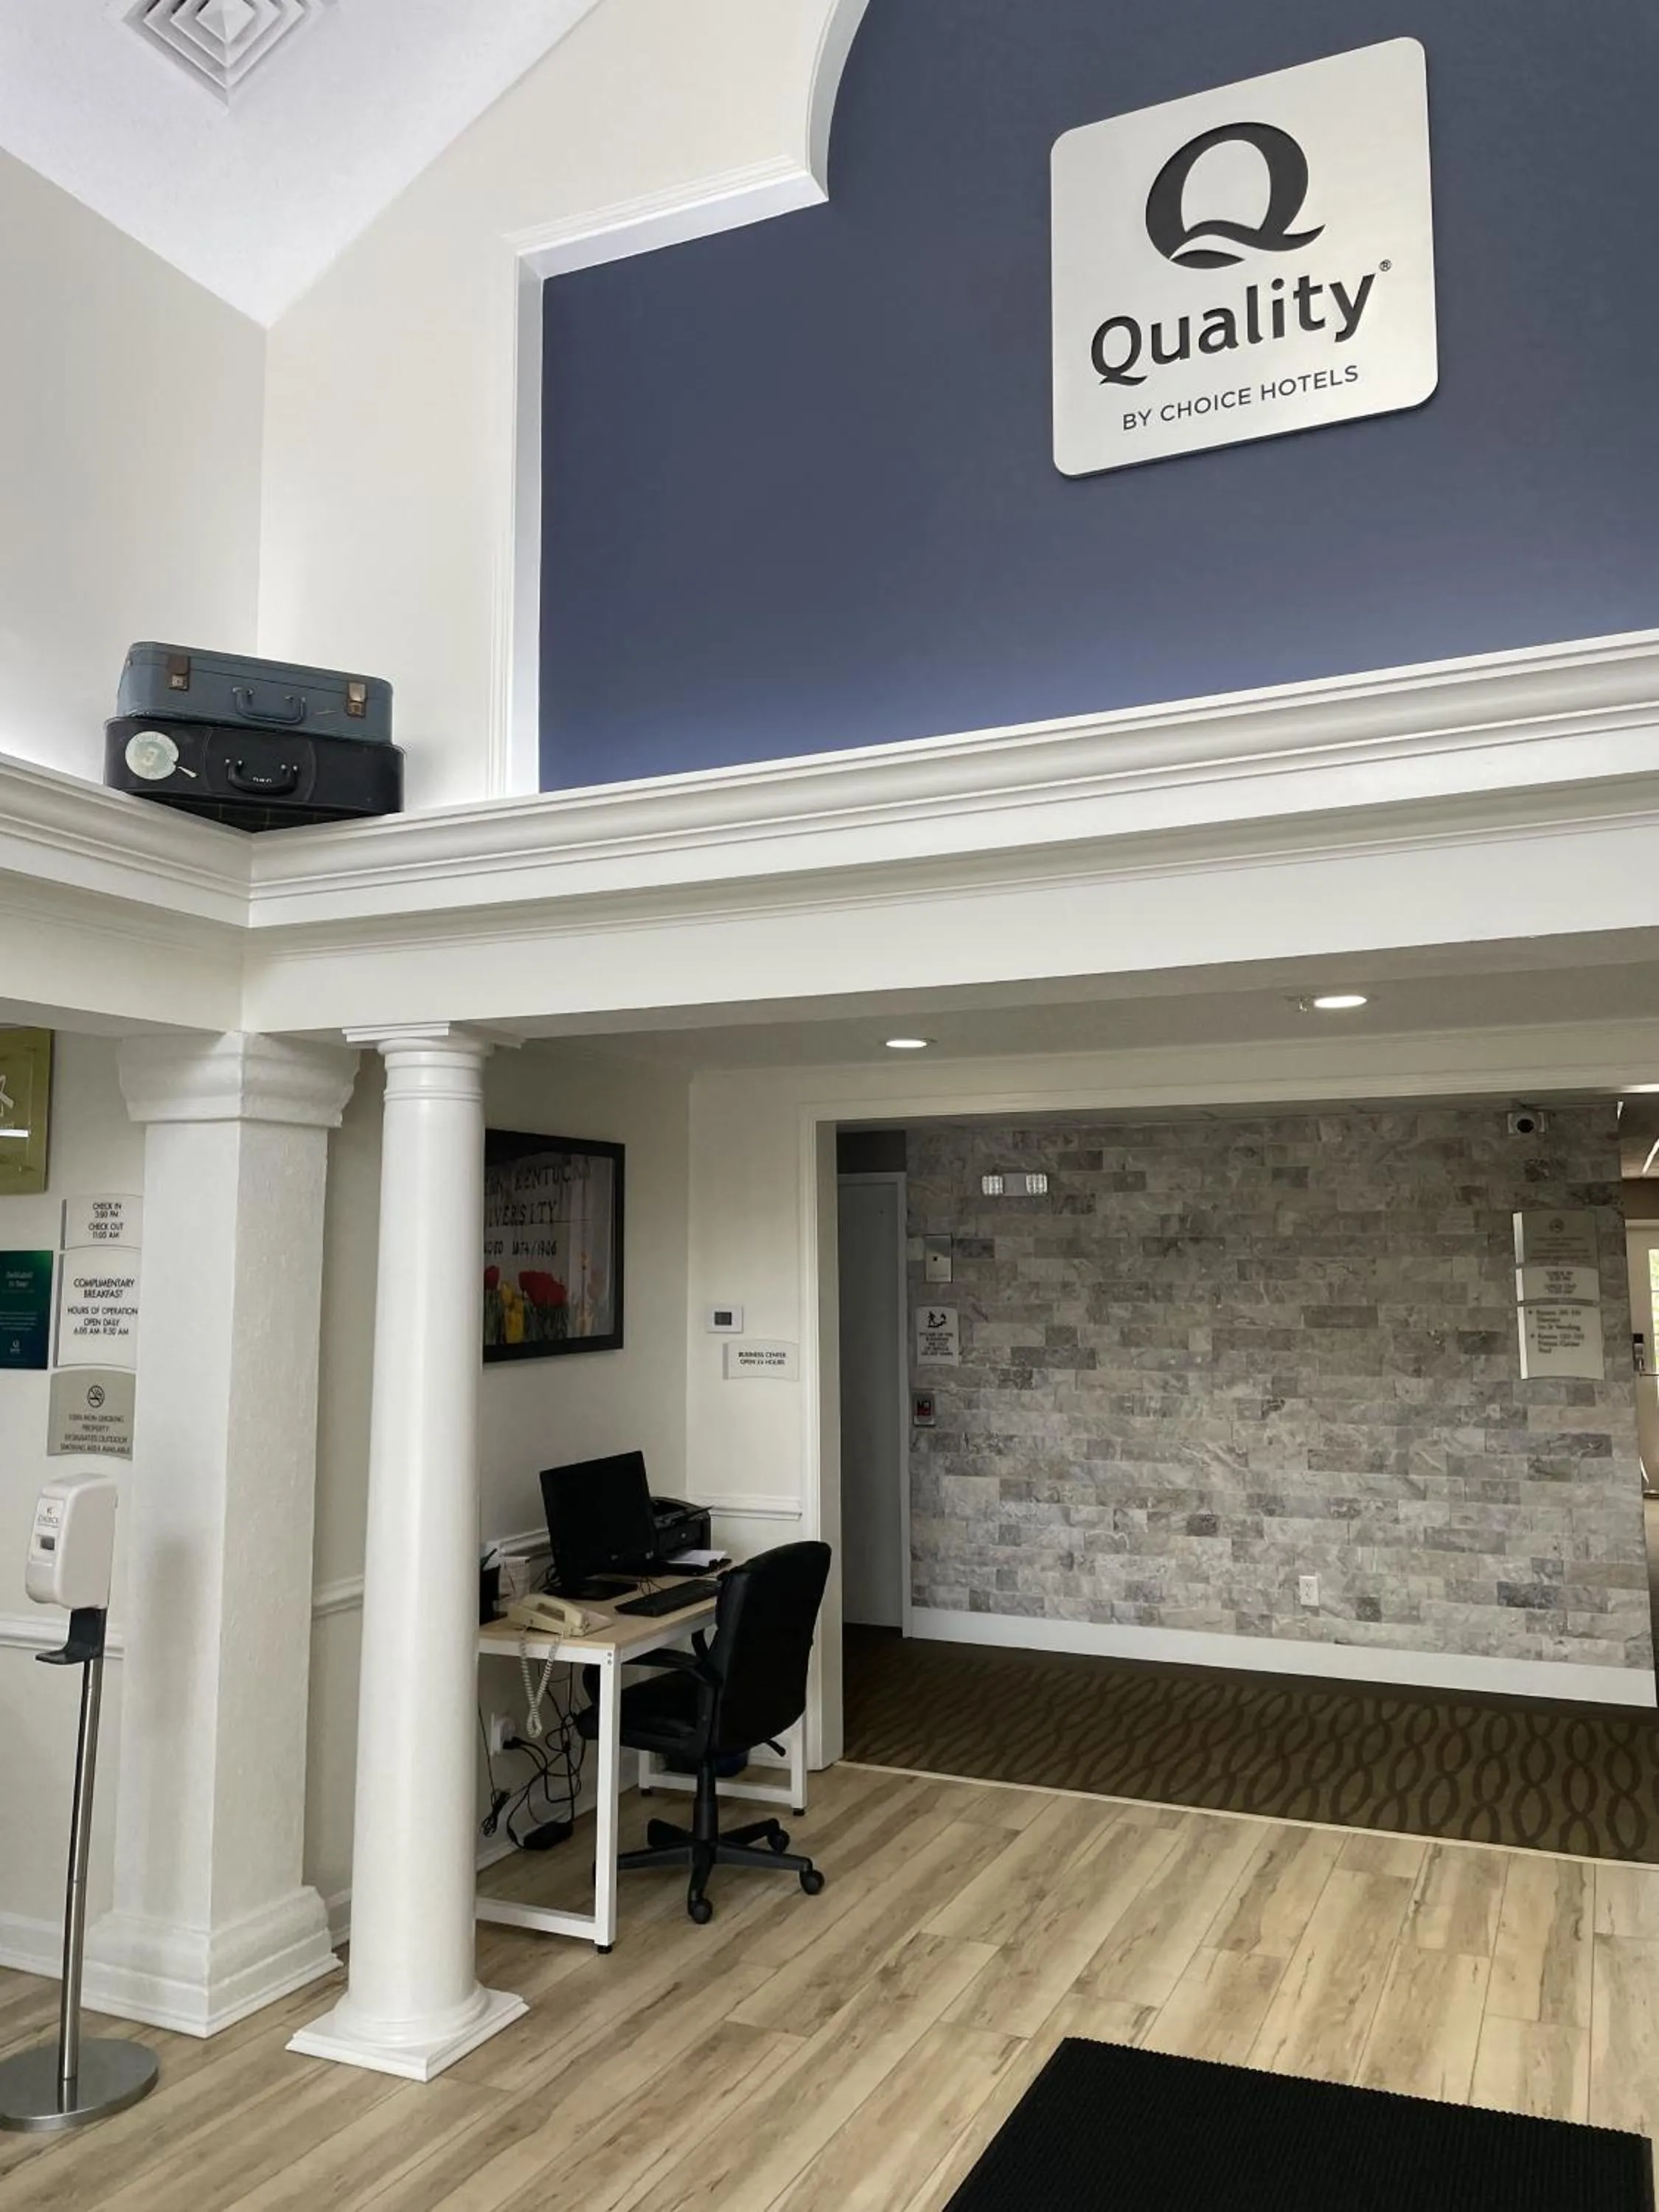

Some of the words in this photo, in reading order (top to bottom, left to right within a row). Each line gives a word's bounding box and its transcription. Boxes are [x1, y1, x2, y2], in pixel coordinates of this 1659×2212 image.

[1091, 273, 1376, 386] Quality
[1122, 408, 1152, 431] BY
[1160, 388, 1252, 423] CHOICE
[1260, 364, 1360, 401] HOTELS
[88, 1222, 109, 1231] CHECK
[110, 1222, 124, 1231] OUT
[73, 1278, 135, 1288] COMPLIMENTARY
[83, 1289, 124, 1298] BREAKFAST
[67, 1306, 89, 1315] HOURS
[90, 1307, 100, 1315] OF
[102, 1307, 139, 1315] OPERATION
[83, 1318, 101, 1326] OPEN
[103, 1318, 120, 1326] DAILY
